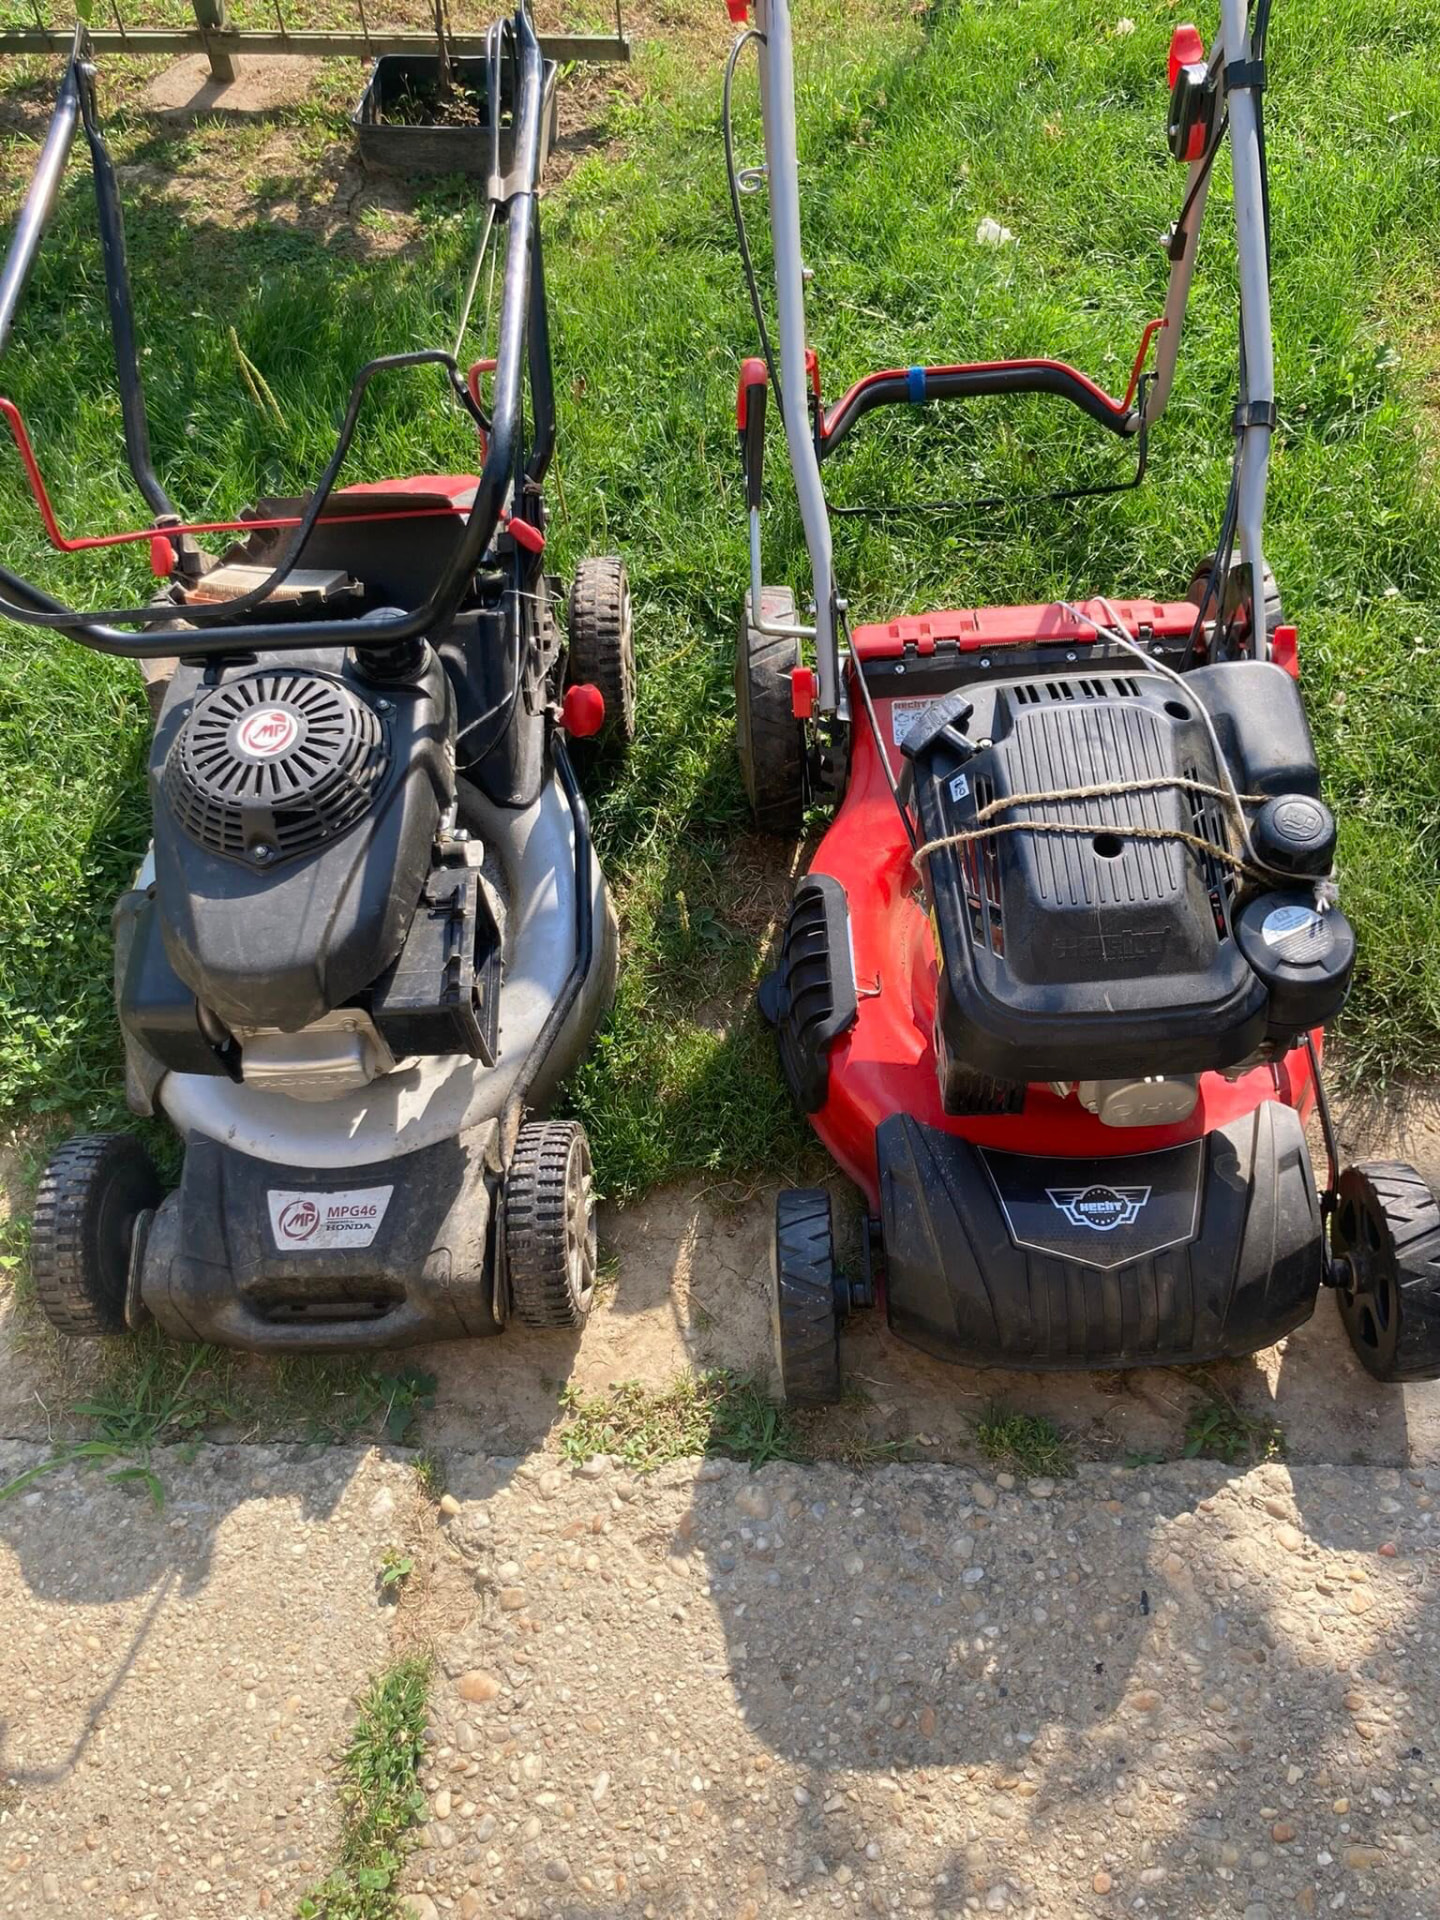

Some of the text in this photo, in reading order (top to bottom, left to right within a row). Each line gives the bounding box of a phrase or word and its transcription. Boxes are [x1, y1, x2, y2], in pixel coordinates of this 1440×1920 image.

[253, 724, 287, 739] MP
[327, 1205, 377, 1218] MPG46
[287, 1213, 316, 1228] MP
[326, 1223, 372, 1231] HONDA
